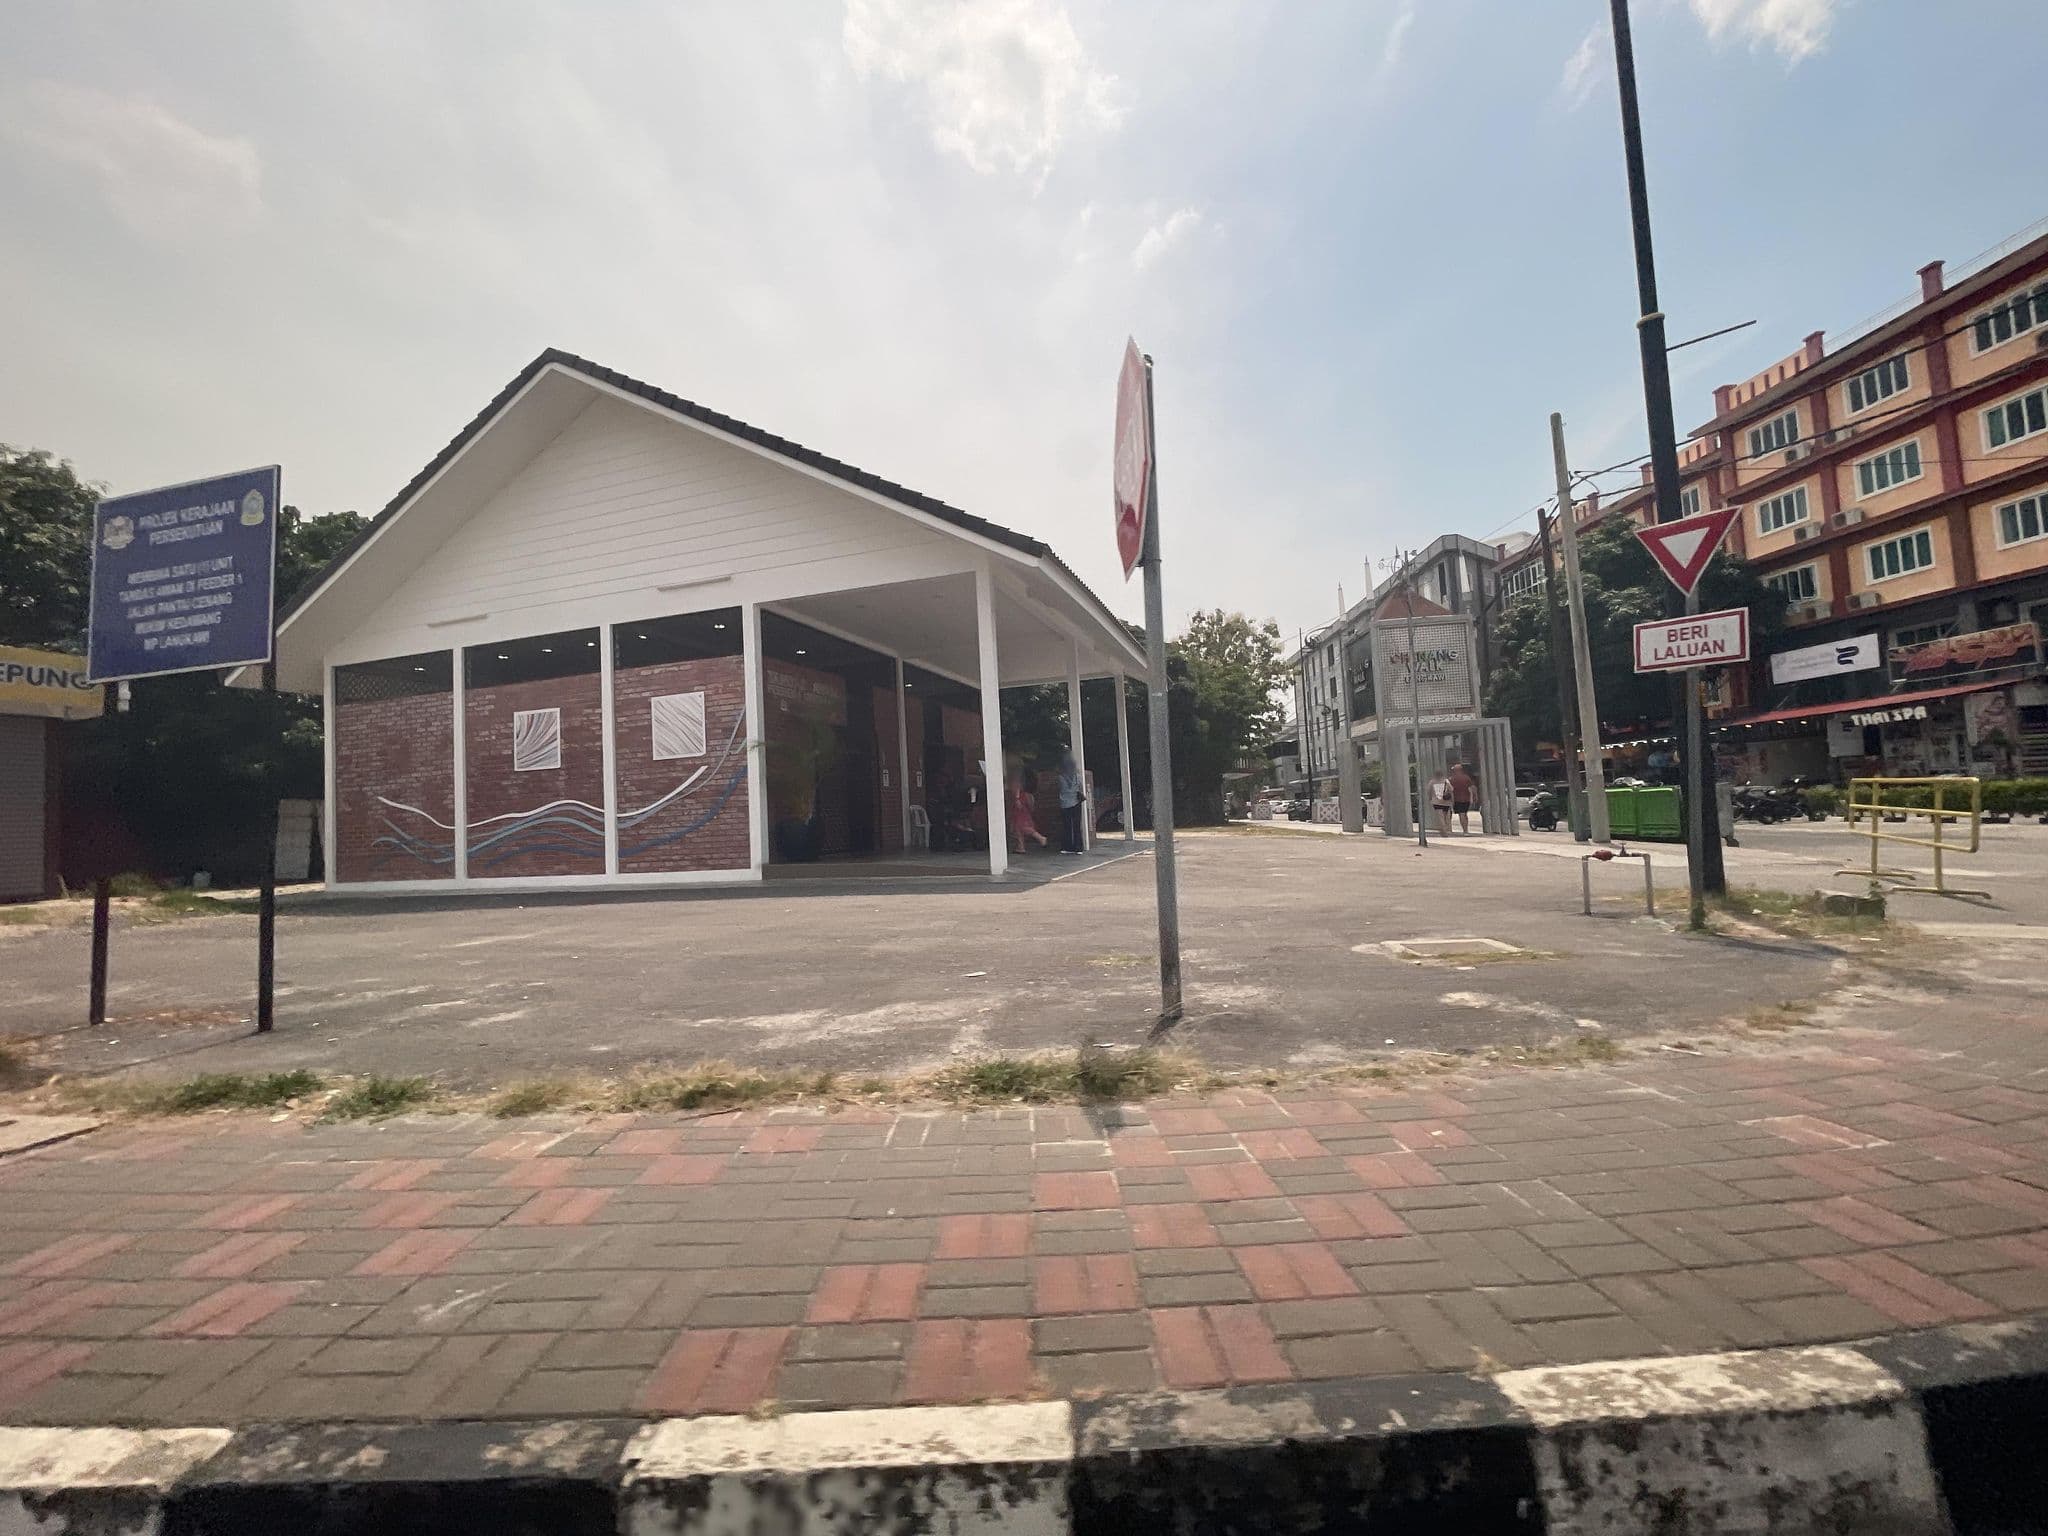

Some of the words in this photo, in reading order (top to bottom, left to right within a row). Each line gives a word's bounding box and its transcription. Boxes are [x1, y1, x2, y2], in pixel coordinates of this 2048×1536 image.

[181, 500, 235, 521] KERAJAAN
[149, 519, 223, 545] PERSEKUTUAN
[1667, 624, 1709, 642] BERI
[1390, 650, 1458, 664] CHNANG
[1654, 639, 1725, 660] LALUAN
[1851, 711, 1890, 727] THAI
[1892, 705, 1927, 721] SPA
